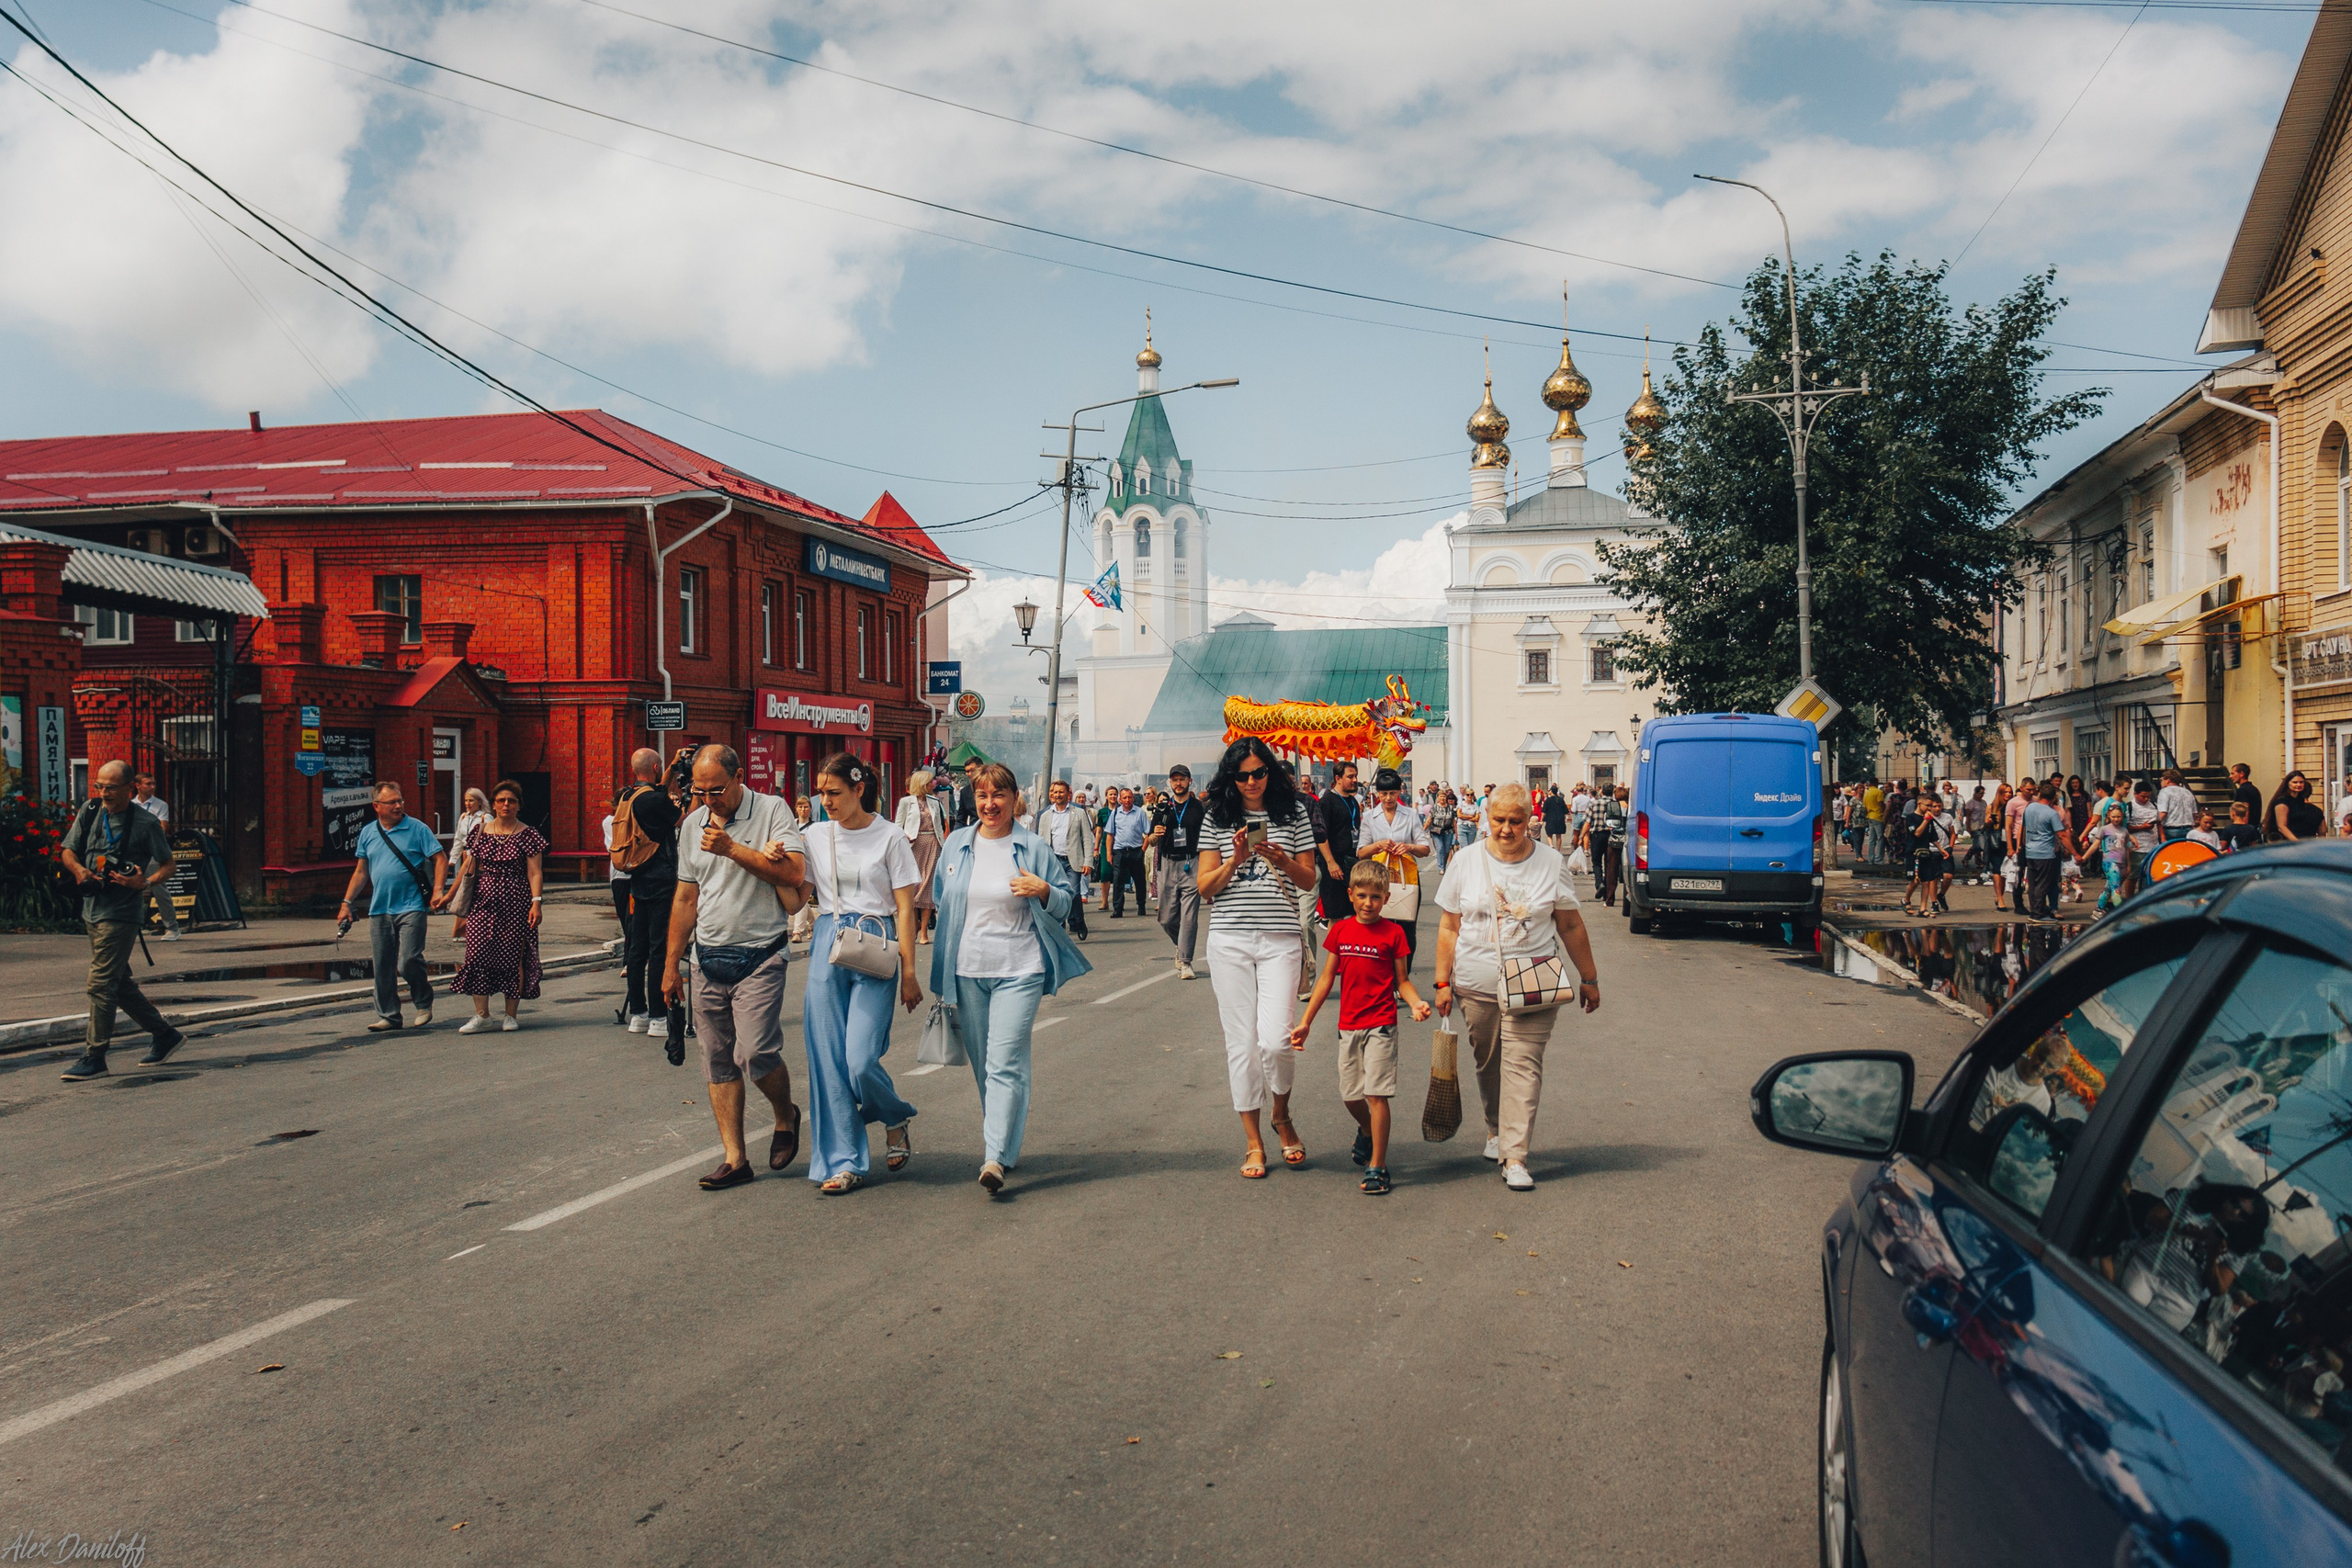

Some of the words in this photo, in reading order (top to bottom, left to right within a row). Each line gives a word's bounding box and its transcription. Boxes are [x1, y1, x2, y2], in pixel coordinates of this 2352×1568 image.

[830, 553, 885, 582] МЕТАЛЛИНВЕСТБАНК
[2301, 641, 2318, 660] АРТ
[2320, 634, 2352, 657] САУНА
[322, 736, 345, 744] VAPE
[331, 795, 349, 806] Аренда
[1754, 793, 1779, 802] Яндекс
[1780, 793, 1802, 802] Драйв
[2162, 862, 2173, 874] 2
